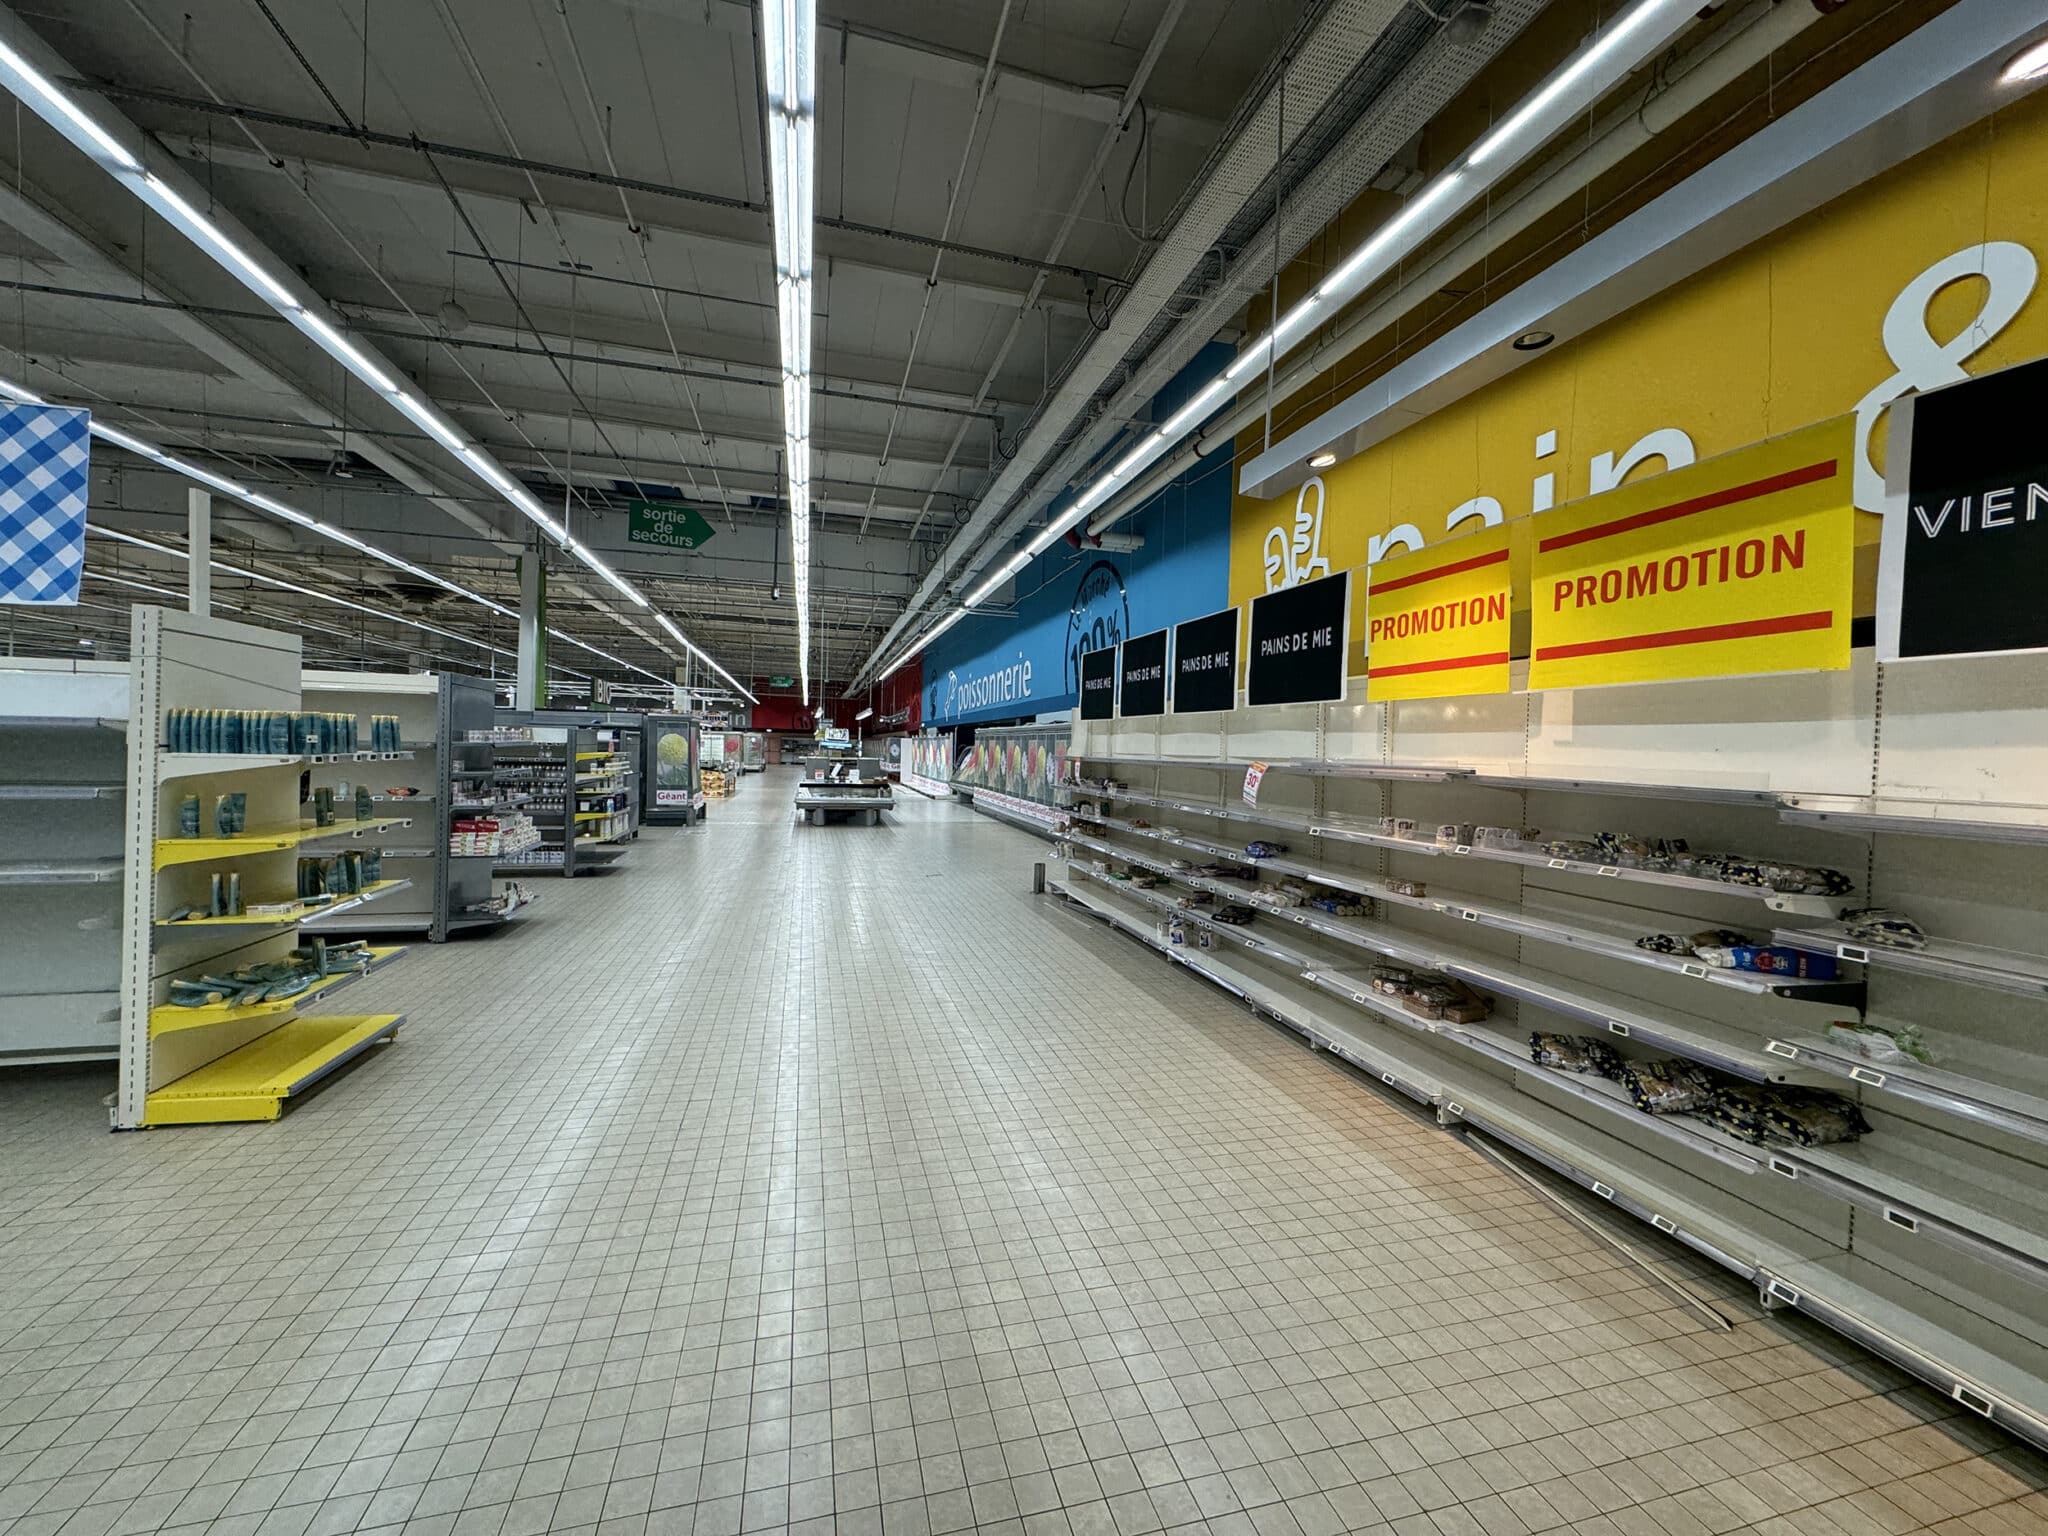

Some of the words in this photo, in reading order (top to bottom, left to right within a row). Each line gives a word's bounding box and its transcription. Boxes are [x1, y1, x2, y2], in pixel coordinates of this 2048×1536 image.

[643, 508, 687, 524] sortie
[654, 520, 673, 534] de
[632, 529, 694, 547] secours
[1553, 529, 1805, 612] PROMOTION
[1370, 592, 1506, 643] PROMOTION
[1261, 635, 1290, 656] PAINS
[1292, 632, 1308, 652] DE
[1312, 626, 1332, 649] MIE
[1182, 657, 1200, 673] PAINS
[1201, 655, 1212, 671] DE
[1214, 651, 1229, 668] MIE
[1126, 669, 1141, 682] PAINS
[1141, 668, 1149, 680] DE
[1151, 665, 1161, 679] MIE
[957, 651, 1032, 720] poissonnerie
[657, 791, 686, 801] Géant
